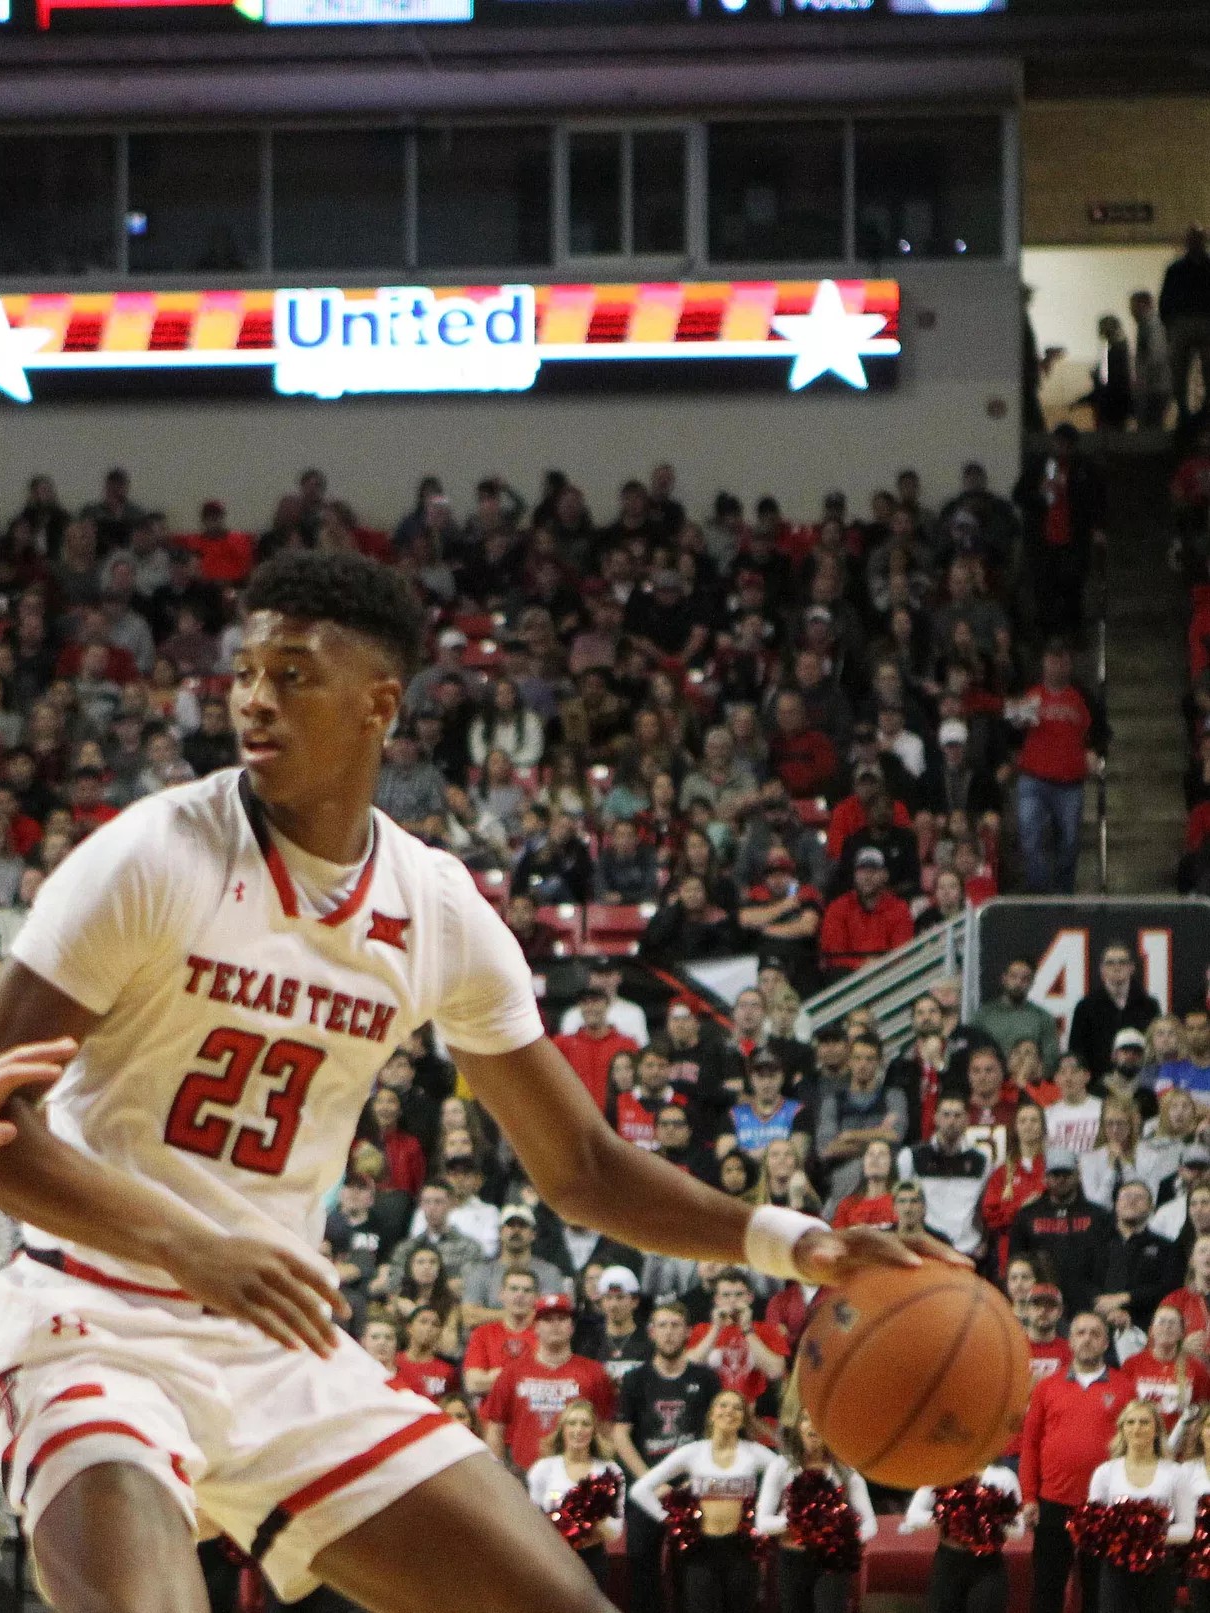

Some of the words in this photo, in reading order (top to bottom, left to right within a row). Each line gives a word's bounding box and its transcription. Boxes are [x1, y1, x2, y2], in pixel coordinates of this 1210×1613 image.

[286, 293, 524, 349] United
[184, 953, 301, 1019] TEXAS
[306, 985, 399, 1045] TECH
[163, 1026, 330, 1178] 23
